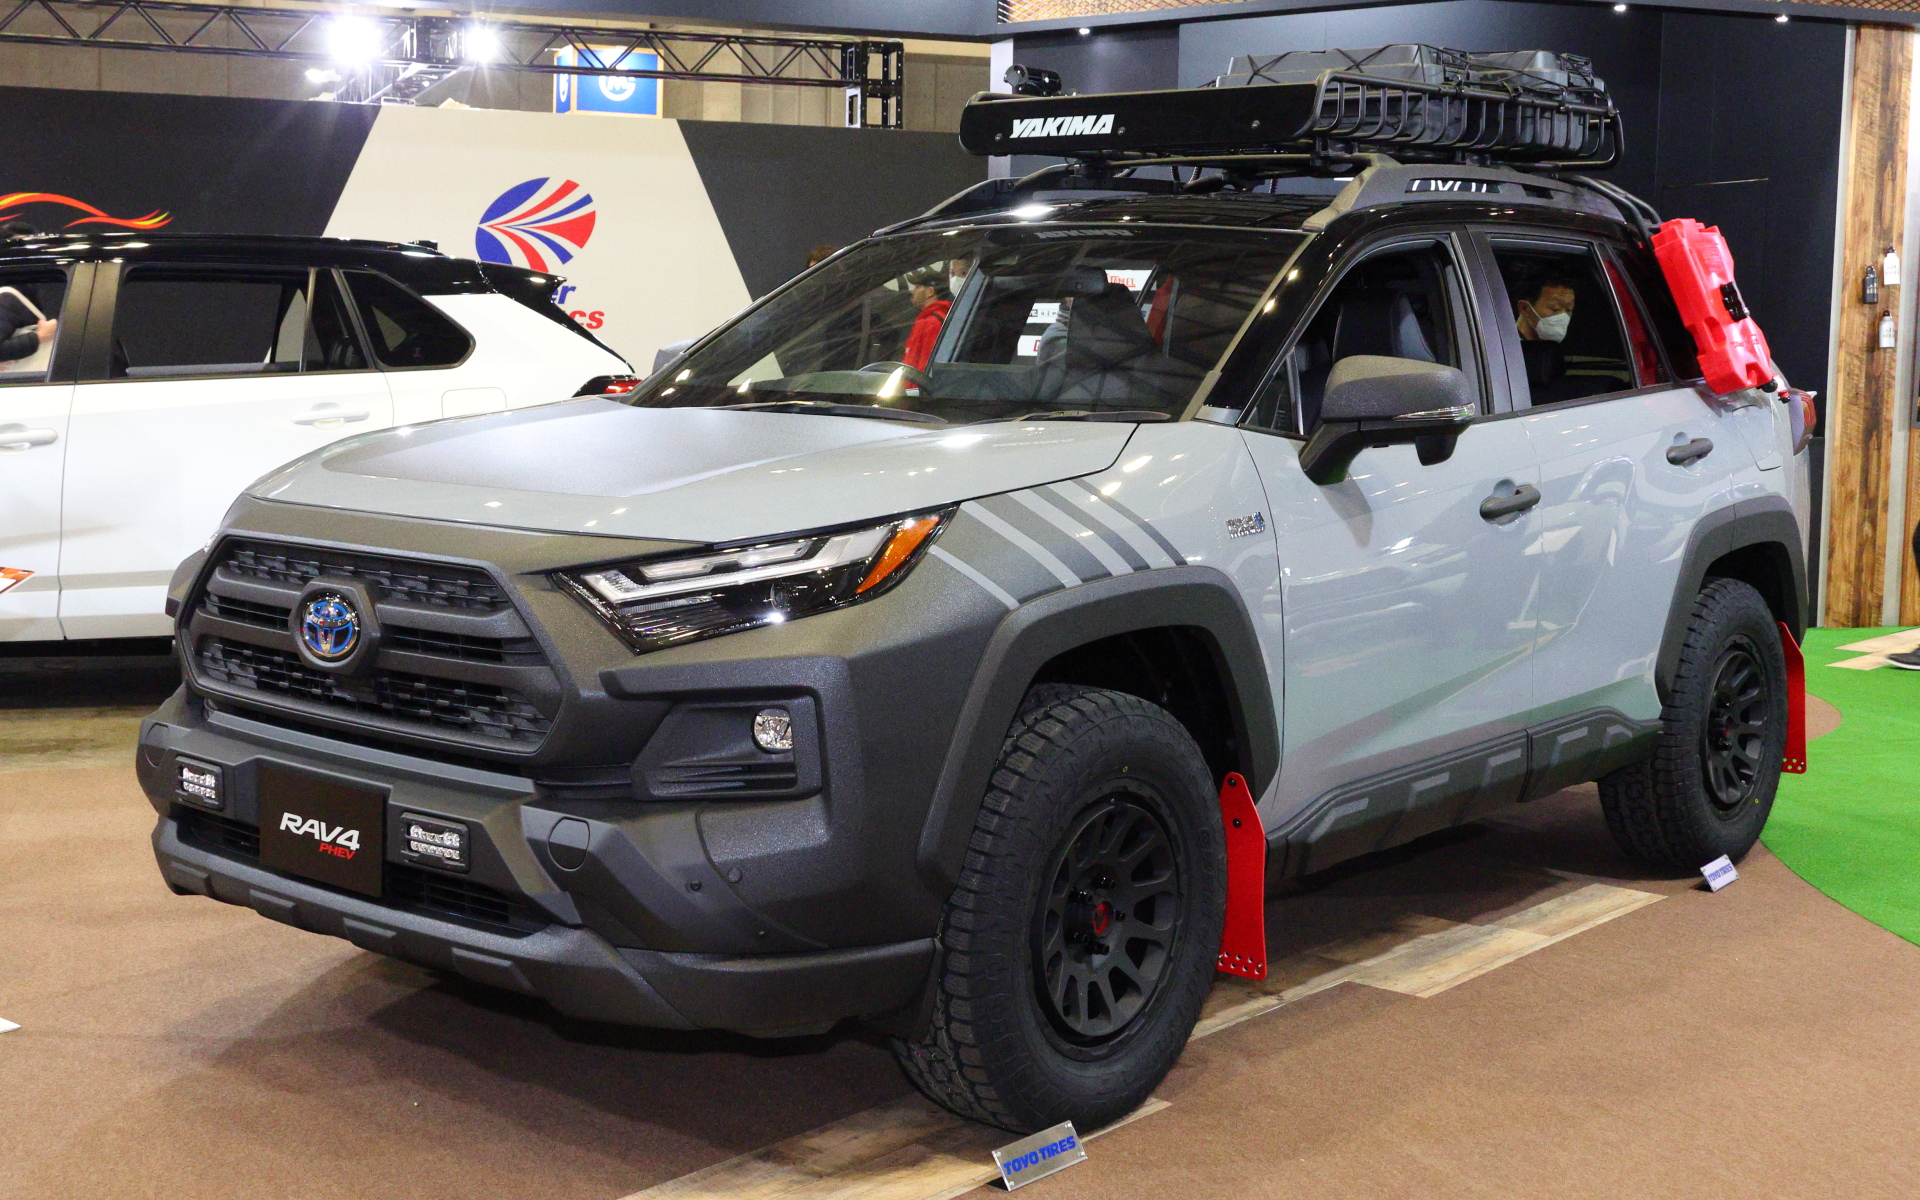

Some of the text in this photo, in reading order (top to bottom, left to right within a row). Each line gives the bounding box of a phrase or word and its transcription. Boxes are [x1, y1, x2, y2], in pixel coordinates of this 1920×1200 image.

[1009, 114, 1115, 138] YAKIMA
[280, 812, 360, 851] RAV4
[319, 843, 356, 860] PHEV
[1003, 1135, 1076, 1175] TOYO TIRES
